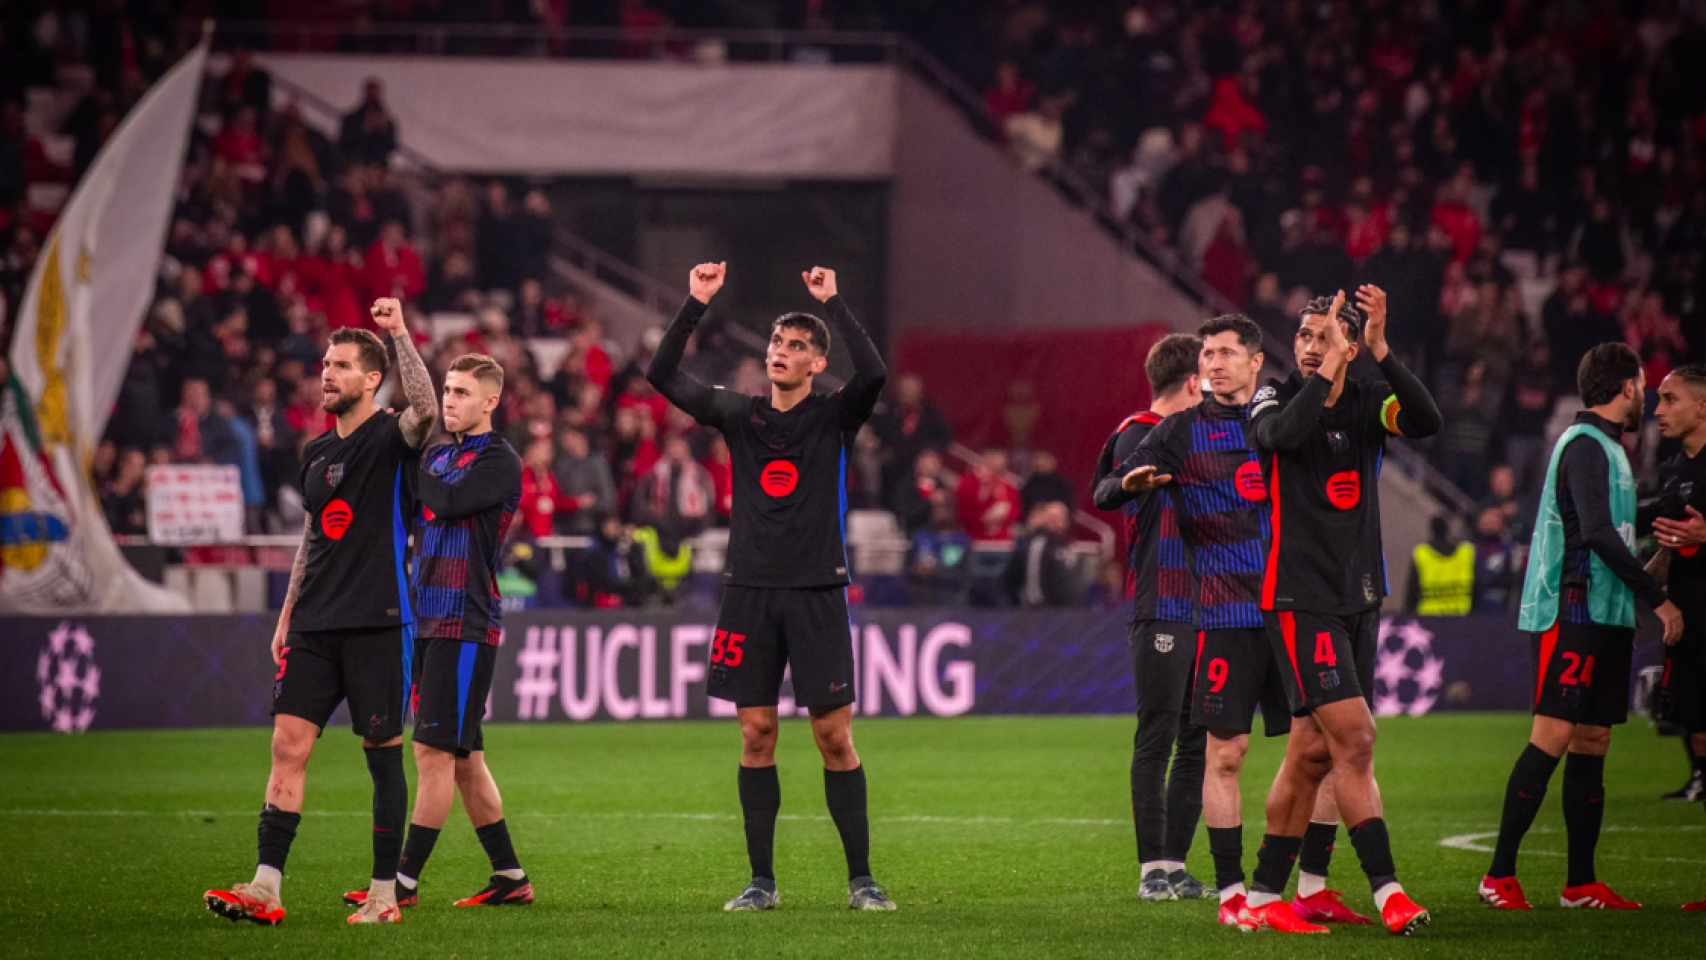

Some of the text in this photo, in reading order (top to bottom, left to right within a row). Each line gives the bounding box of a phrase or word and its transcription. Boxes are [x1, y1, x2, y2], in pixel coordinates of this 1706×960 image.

[275, 646, 291, 680] 5
[711, 628, 746, 667] 35
[1313, 631, 1337, 666] 4
[514, 622, 976, 720] #UCLFNG
[1207, 657, 1229, 693] 9
[1558, 651, 1595, 688] 24
